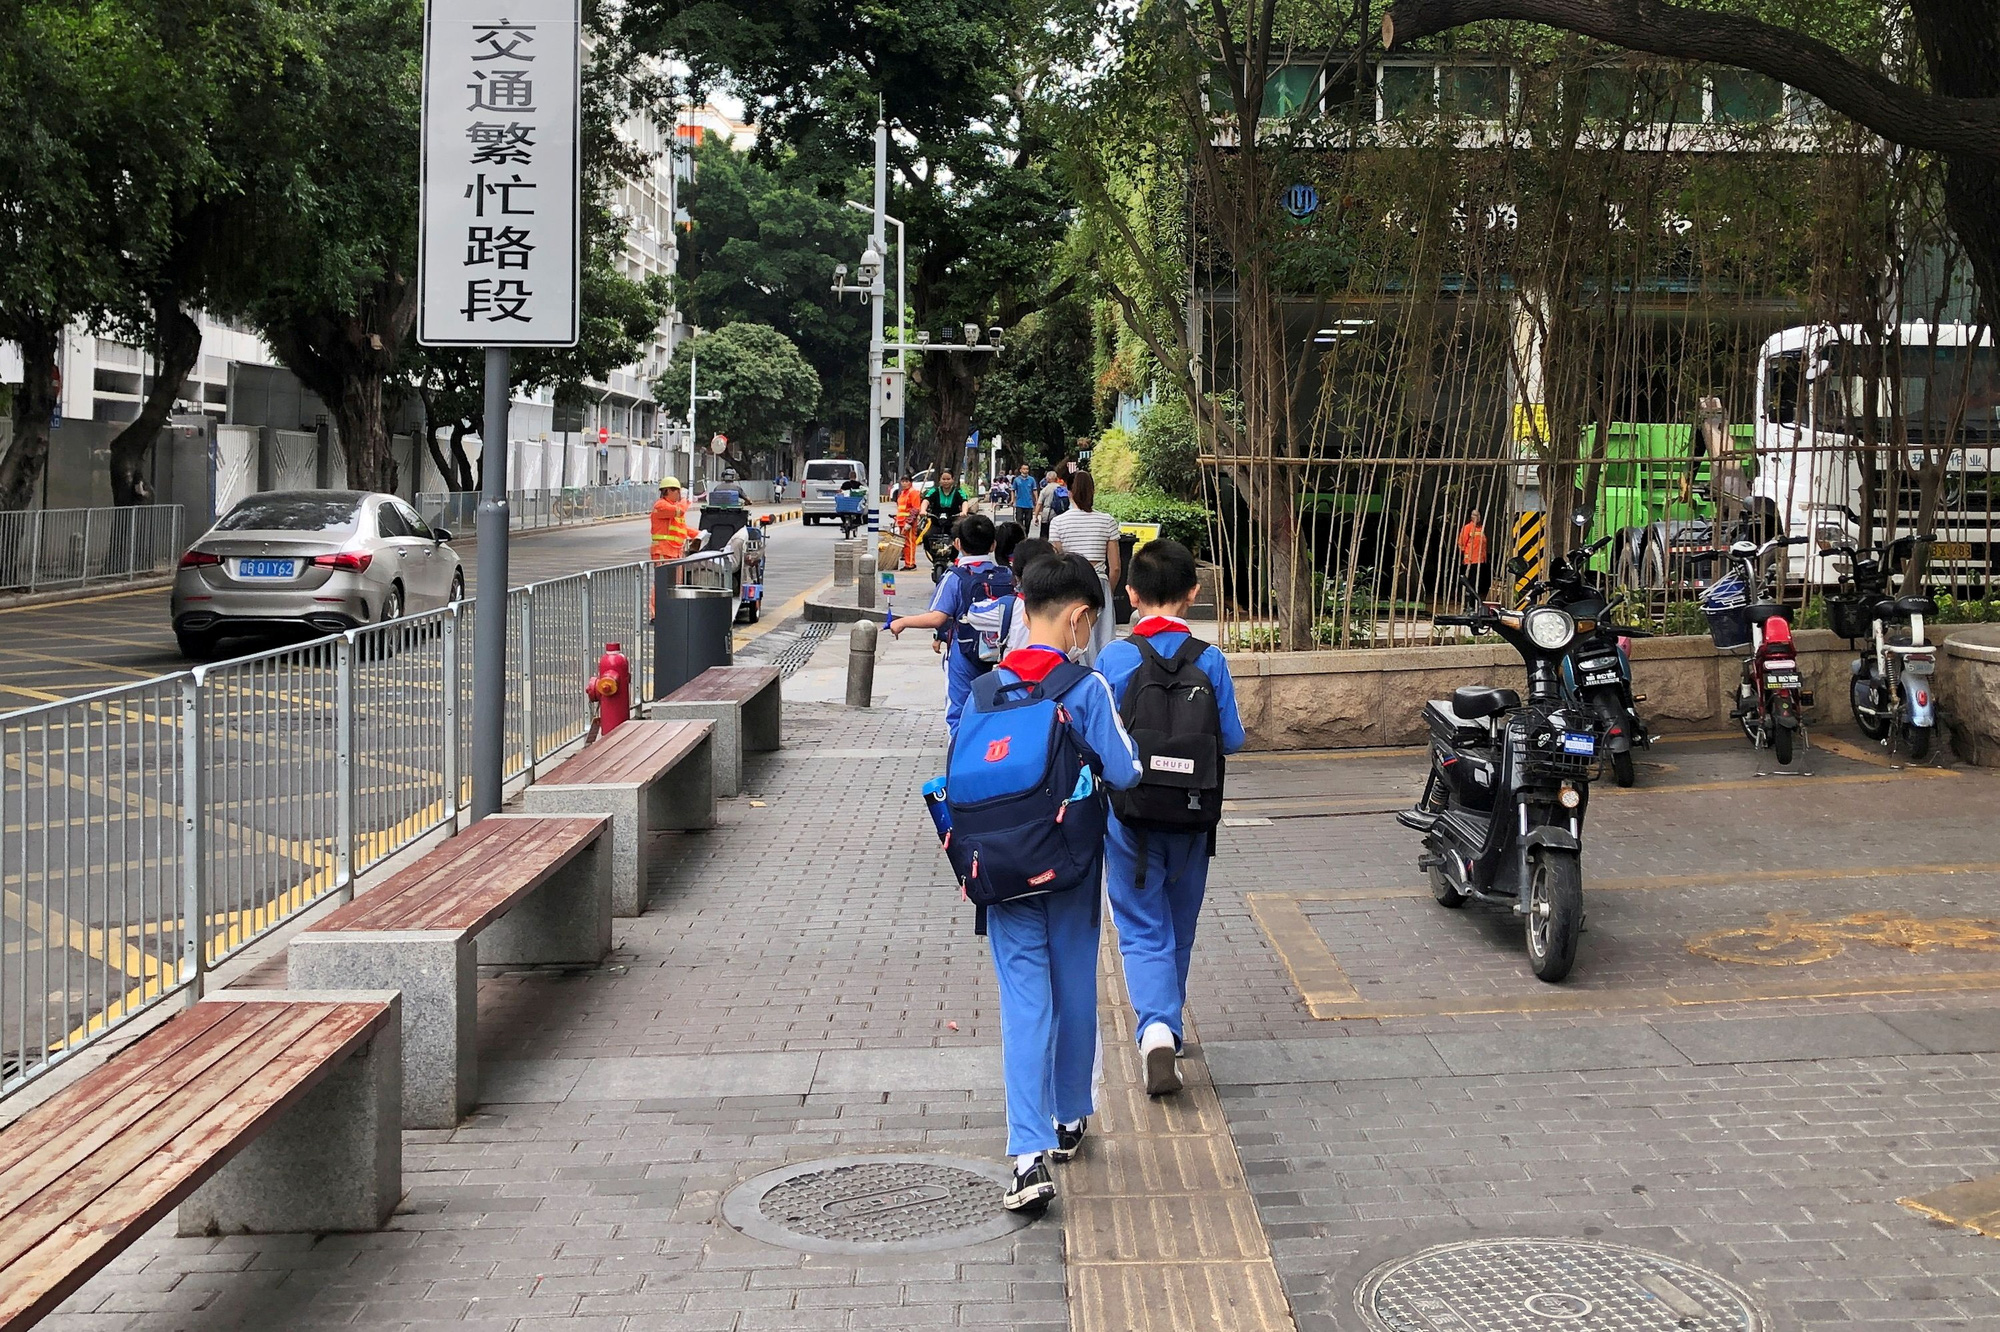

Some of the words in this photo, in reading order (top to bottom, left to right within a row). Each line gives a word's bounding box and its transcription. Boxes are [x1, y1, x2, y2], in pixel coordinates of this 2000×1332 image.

[460, 17, 537, 323] 交通繁忙路段
[1155, 759, 1190, 769] CHUFU
